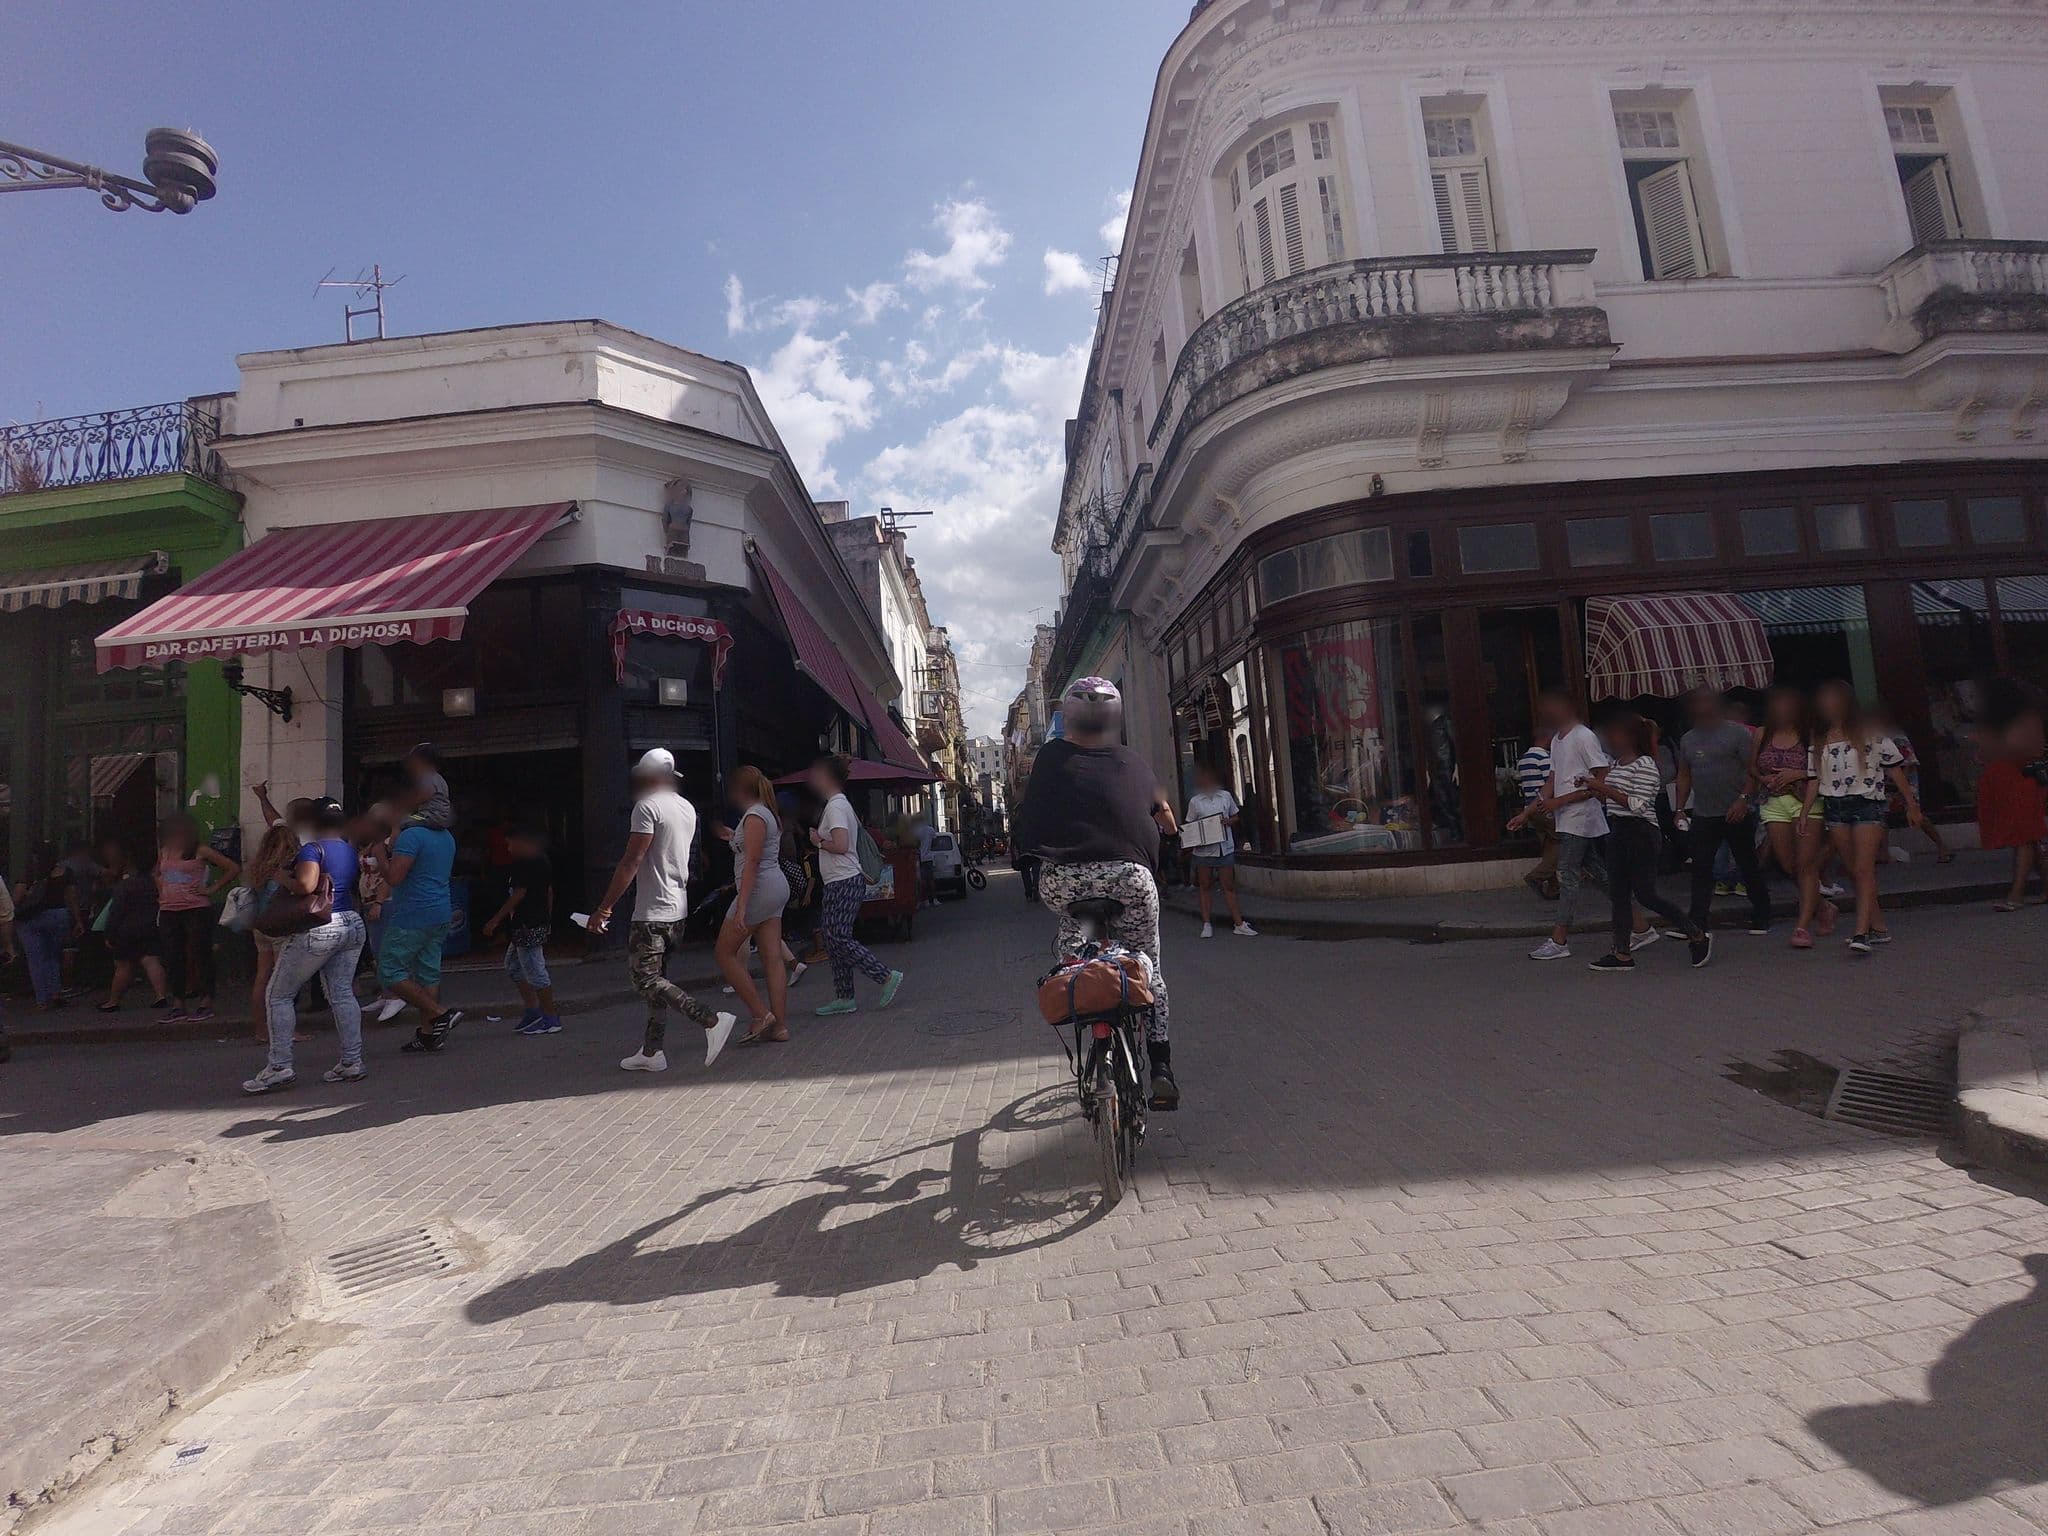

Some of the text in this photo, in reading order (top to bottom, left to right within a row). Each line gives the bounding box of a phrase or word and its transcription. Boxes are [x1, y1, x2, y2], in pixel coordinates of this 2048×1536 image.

[627, 615, 716, 635] LA DICHOSA
[145, 623, 412, 658] BAR-CAFETERÍA LA DICHOSA
